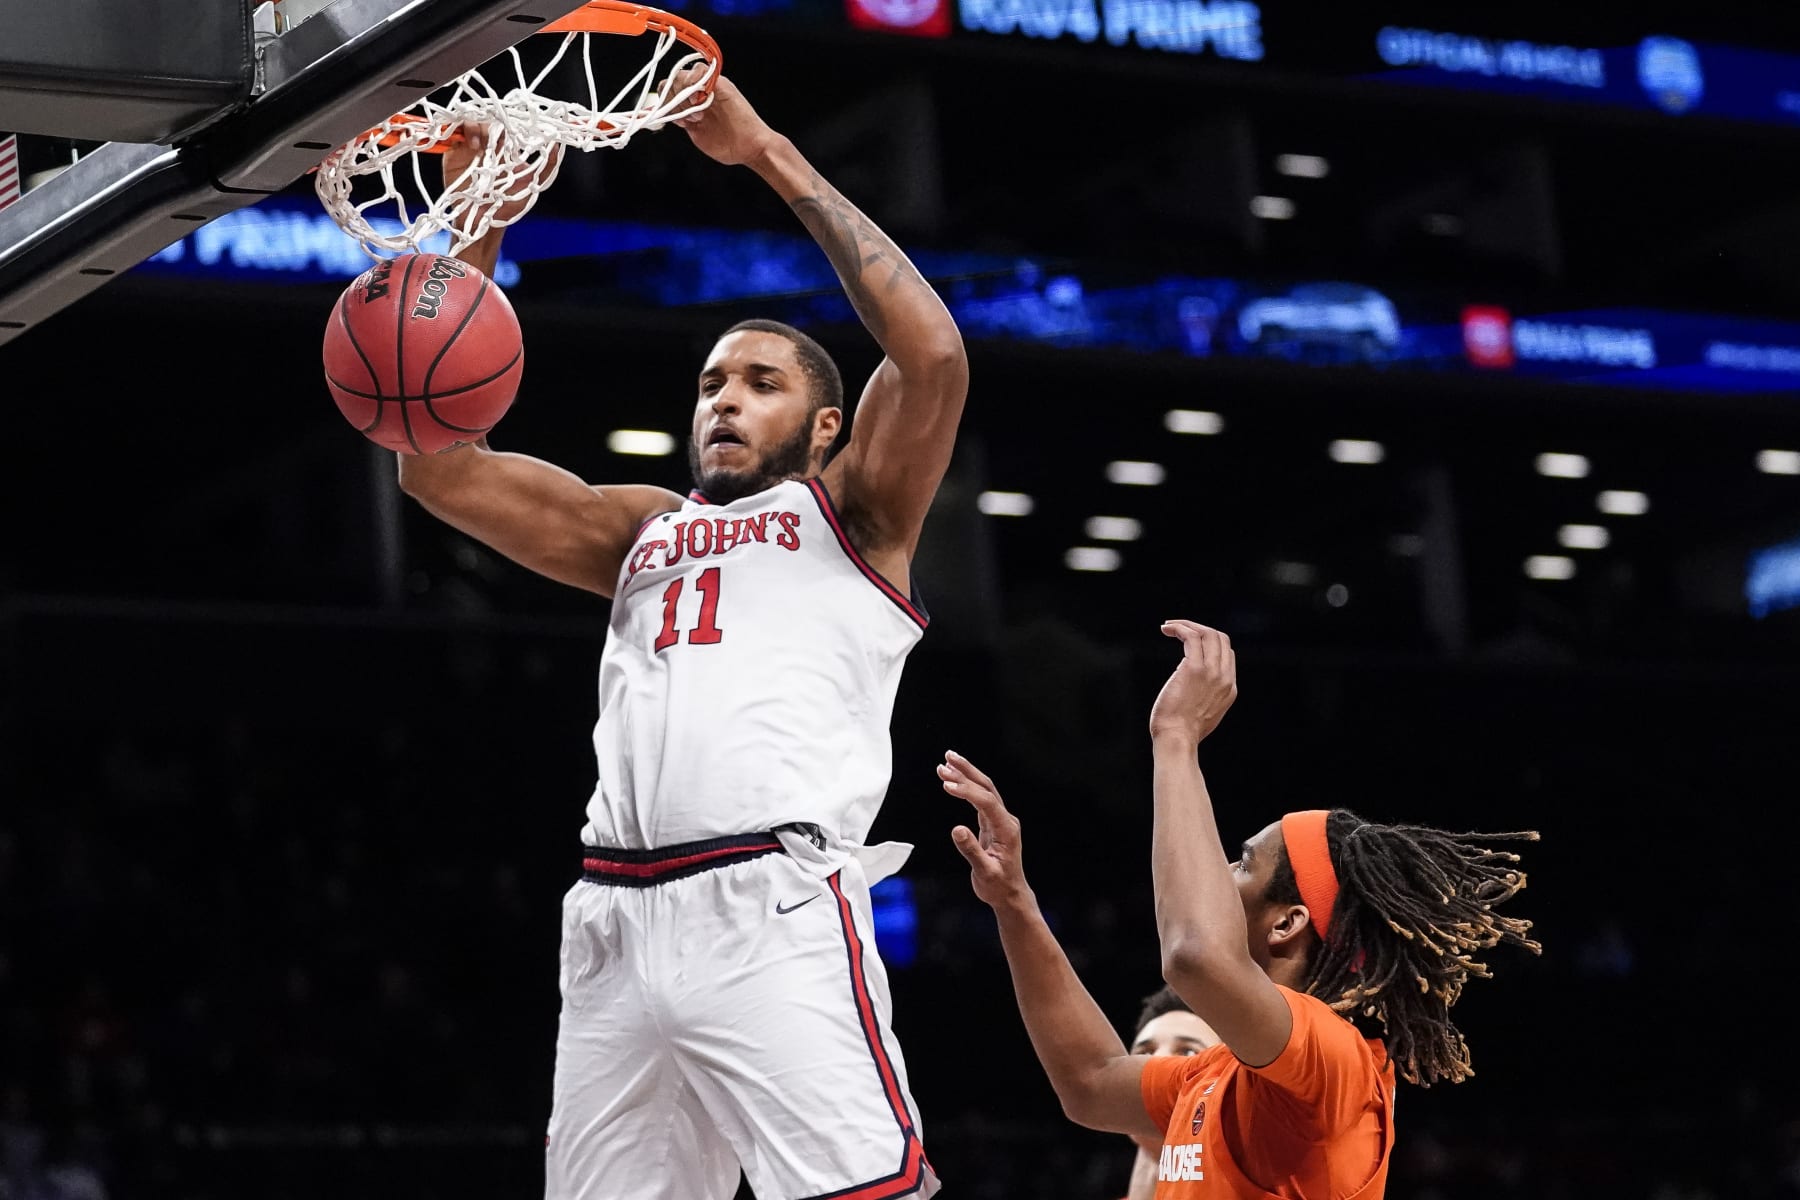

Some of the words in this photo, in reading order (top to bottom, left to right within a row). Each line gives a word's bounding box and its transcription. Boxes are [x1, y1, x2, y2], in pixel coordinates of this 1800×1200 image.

[411, 254, 466, 320] ilson
[665, 511, 800, 568] JOHN'S
[654, 566, 723, 656] 11
